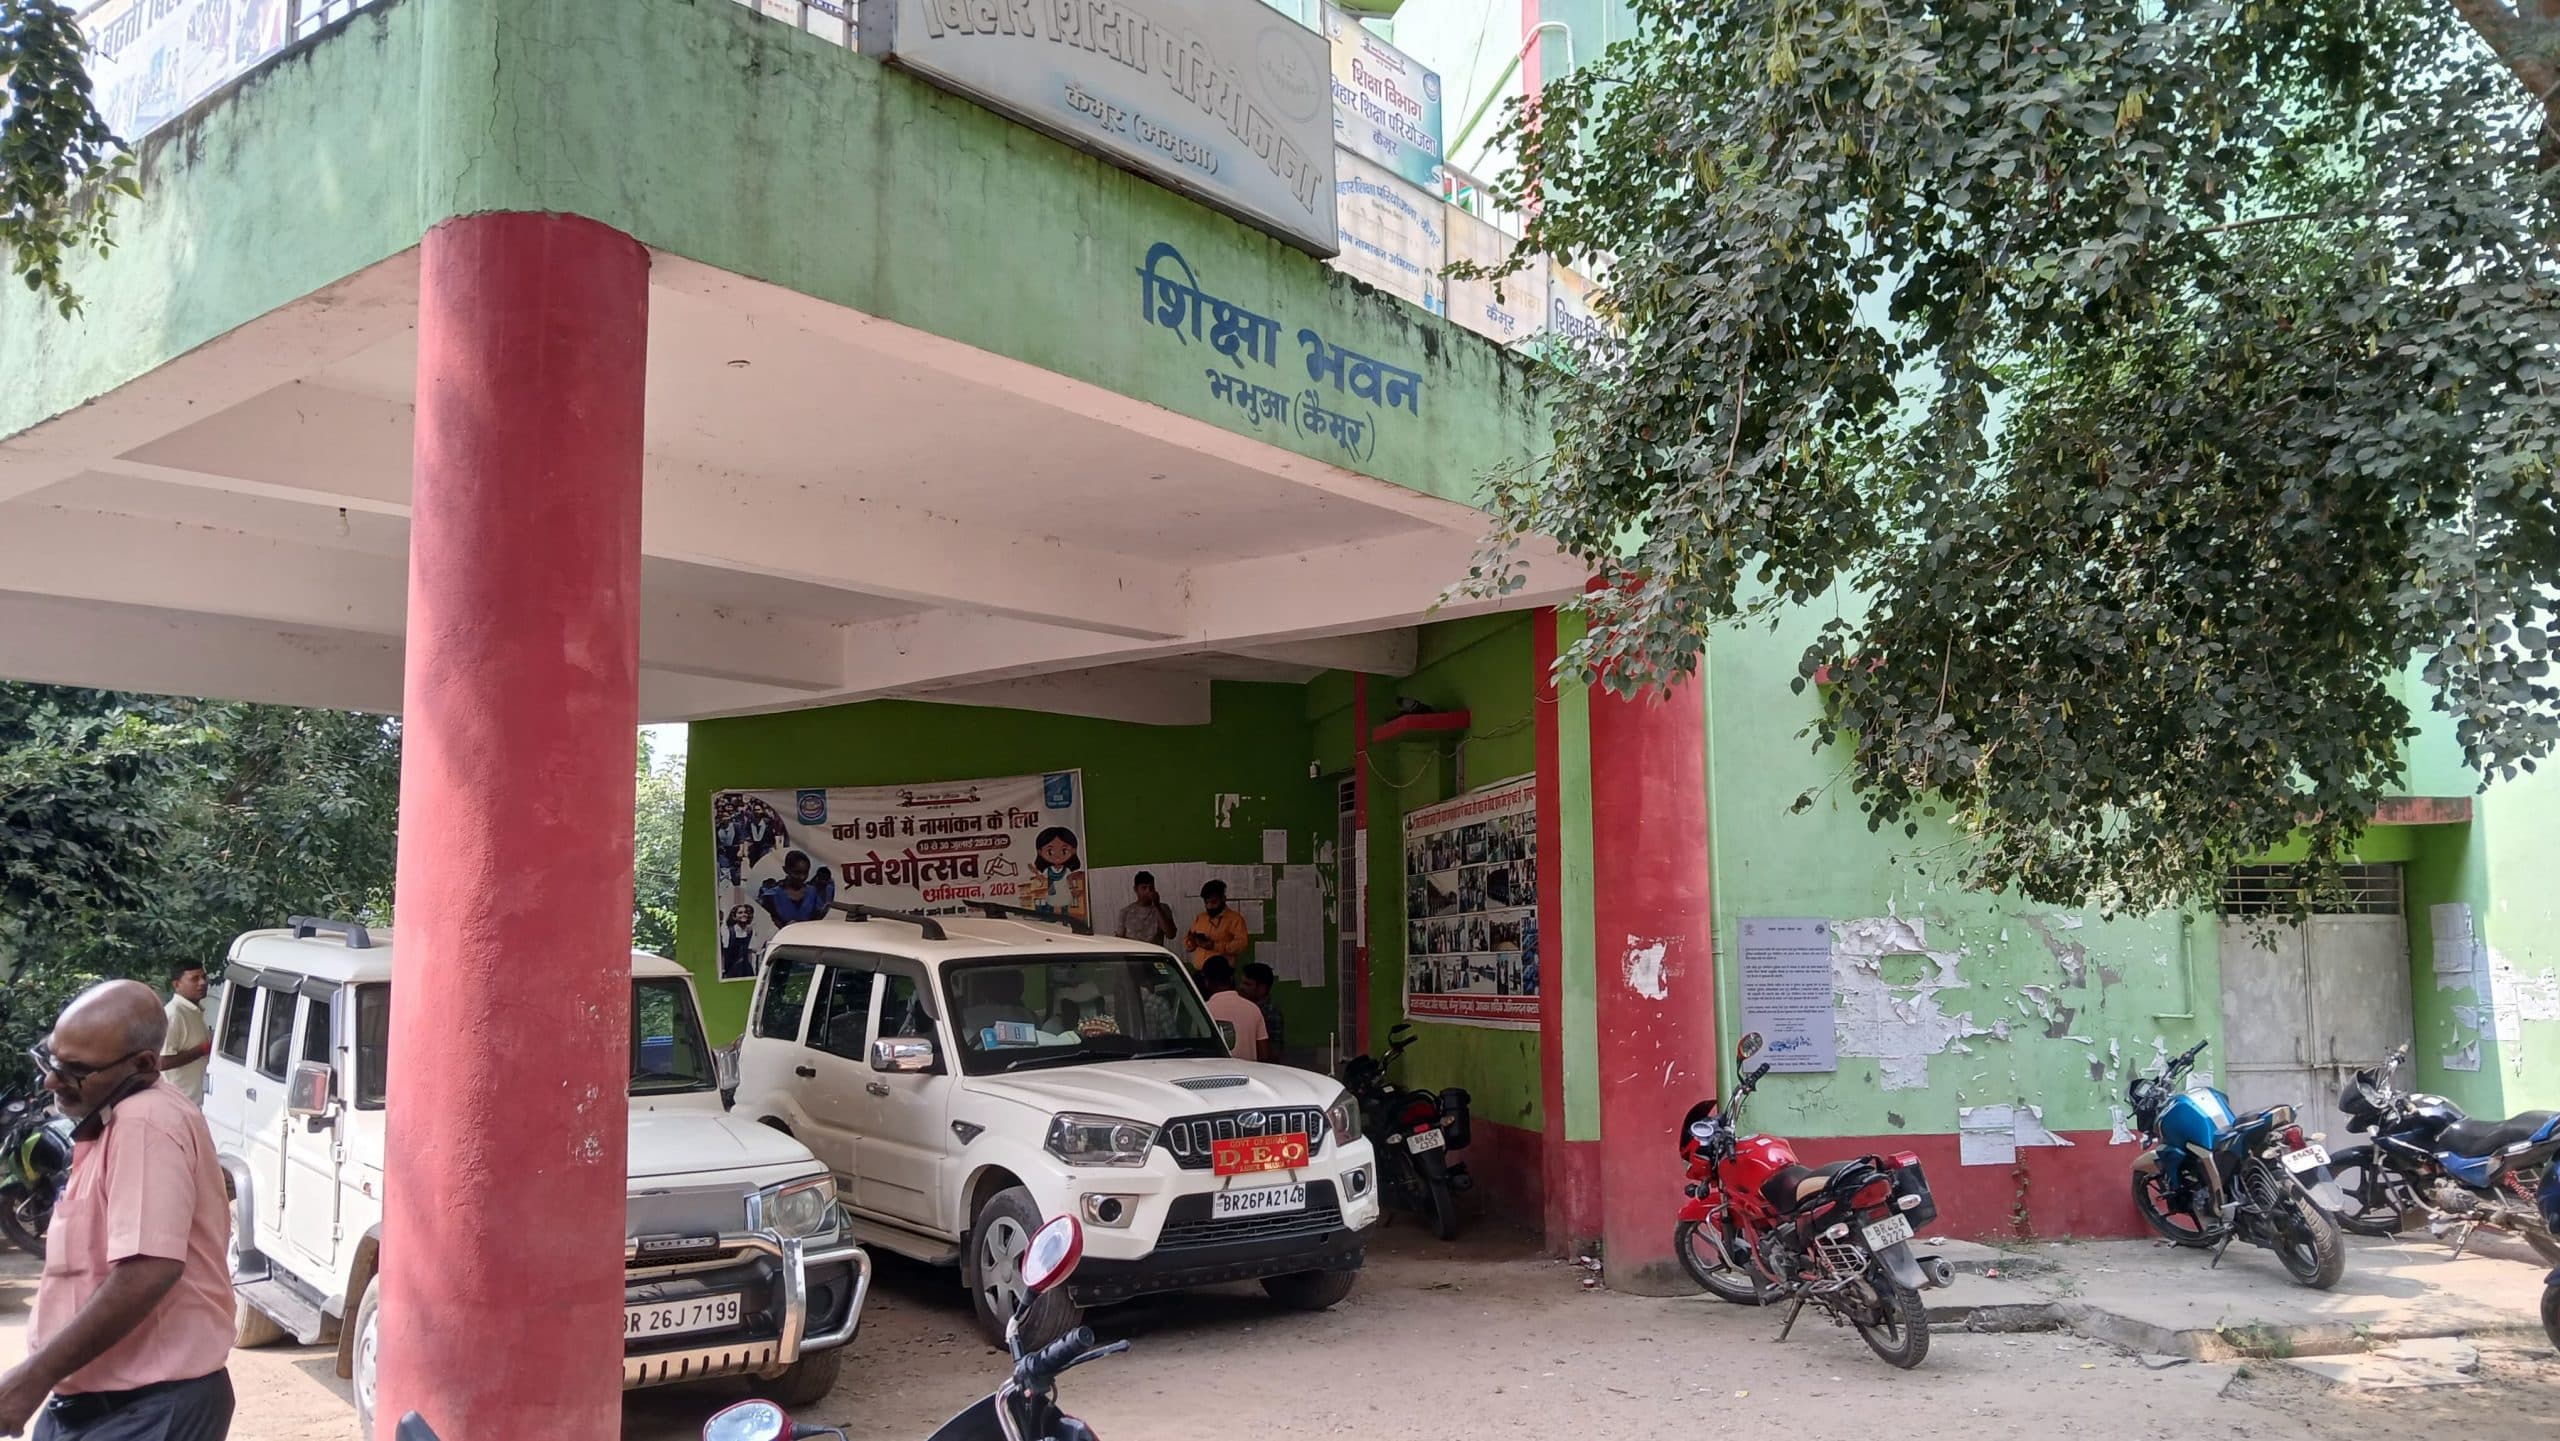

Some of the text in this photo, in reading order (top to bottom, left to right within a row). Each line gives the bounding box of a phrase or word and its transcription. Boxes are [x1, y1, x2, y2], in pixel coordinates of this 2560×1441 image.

[1352, 58, 1382, 98] शिक्षा
[1384, 78, 1423, 121] विभाग
[1155, 23, 1322, 214] परियोजना
[1360, 91, 1386, 127] शिक्षा
[1389, 112, 1436, 156] परियोजना
[1136, 242, 1424, 417] शिक्षा भवन
[1486, 303, 1516, 336] कैमूर
[1205, 369, 1376, 464] भभुआ (कैमूर)
[832, 807, 1040, 841] वर्ग 9वीं में नामांकन के लिए
[840, 848, 979, 891] प्रवेशोत्सव
[923, 882, 1016, 903] अभियान, 2023
[1217, 1143, 1304, 1168] D.E.O
[692, 1300, 738, 1325] 7199
